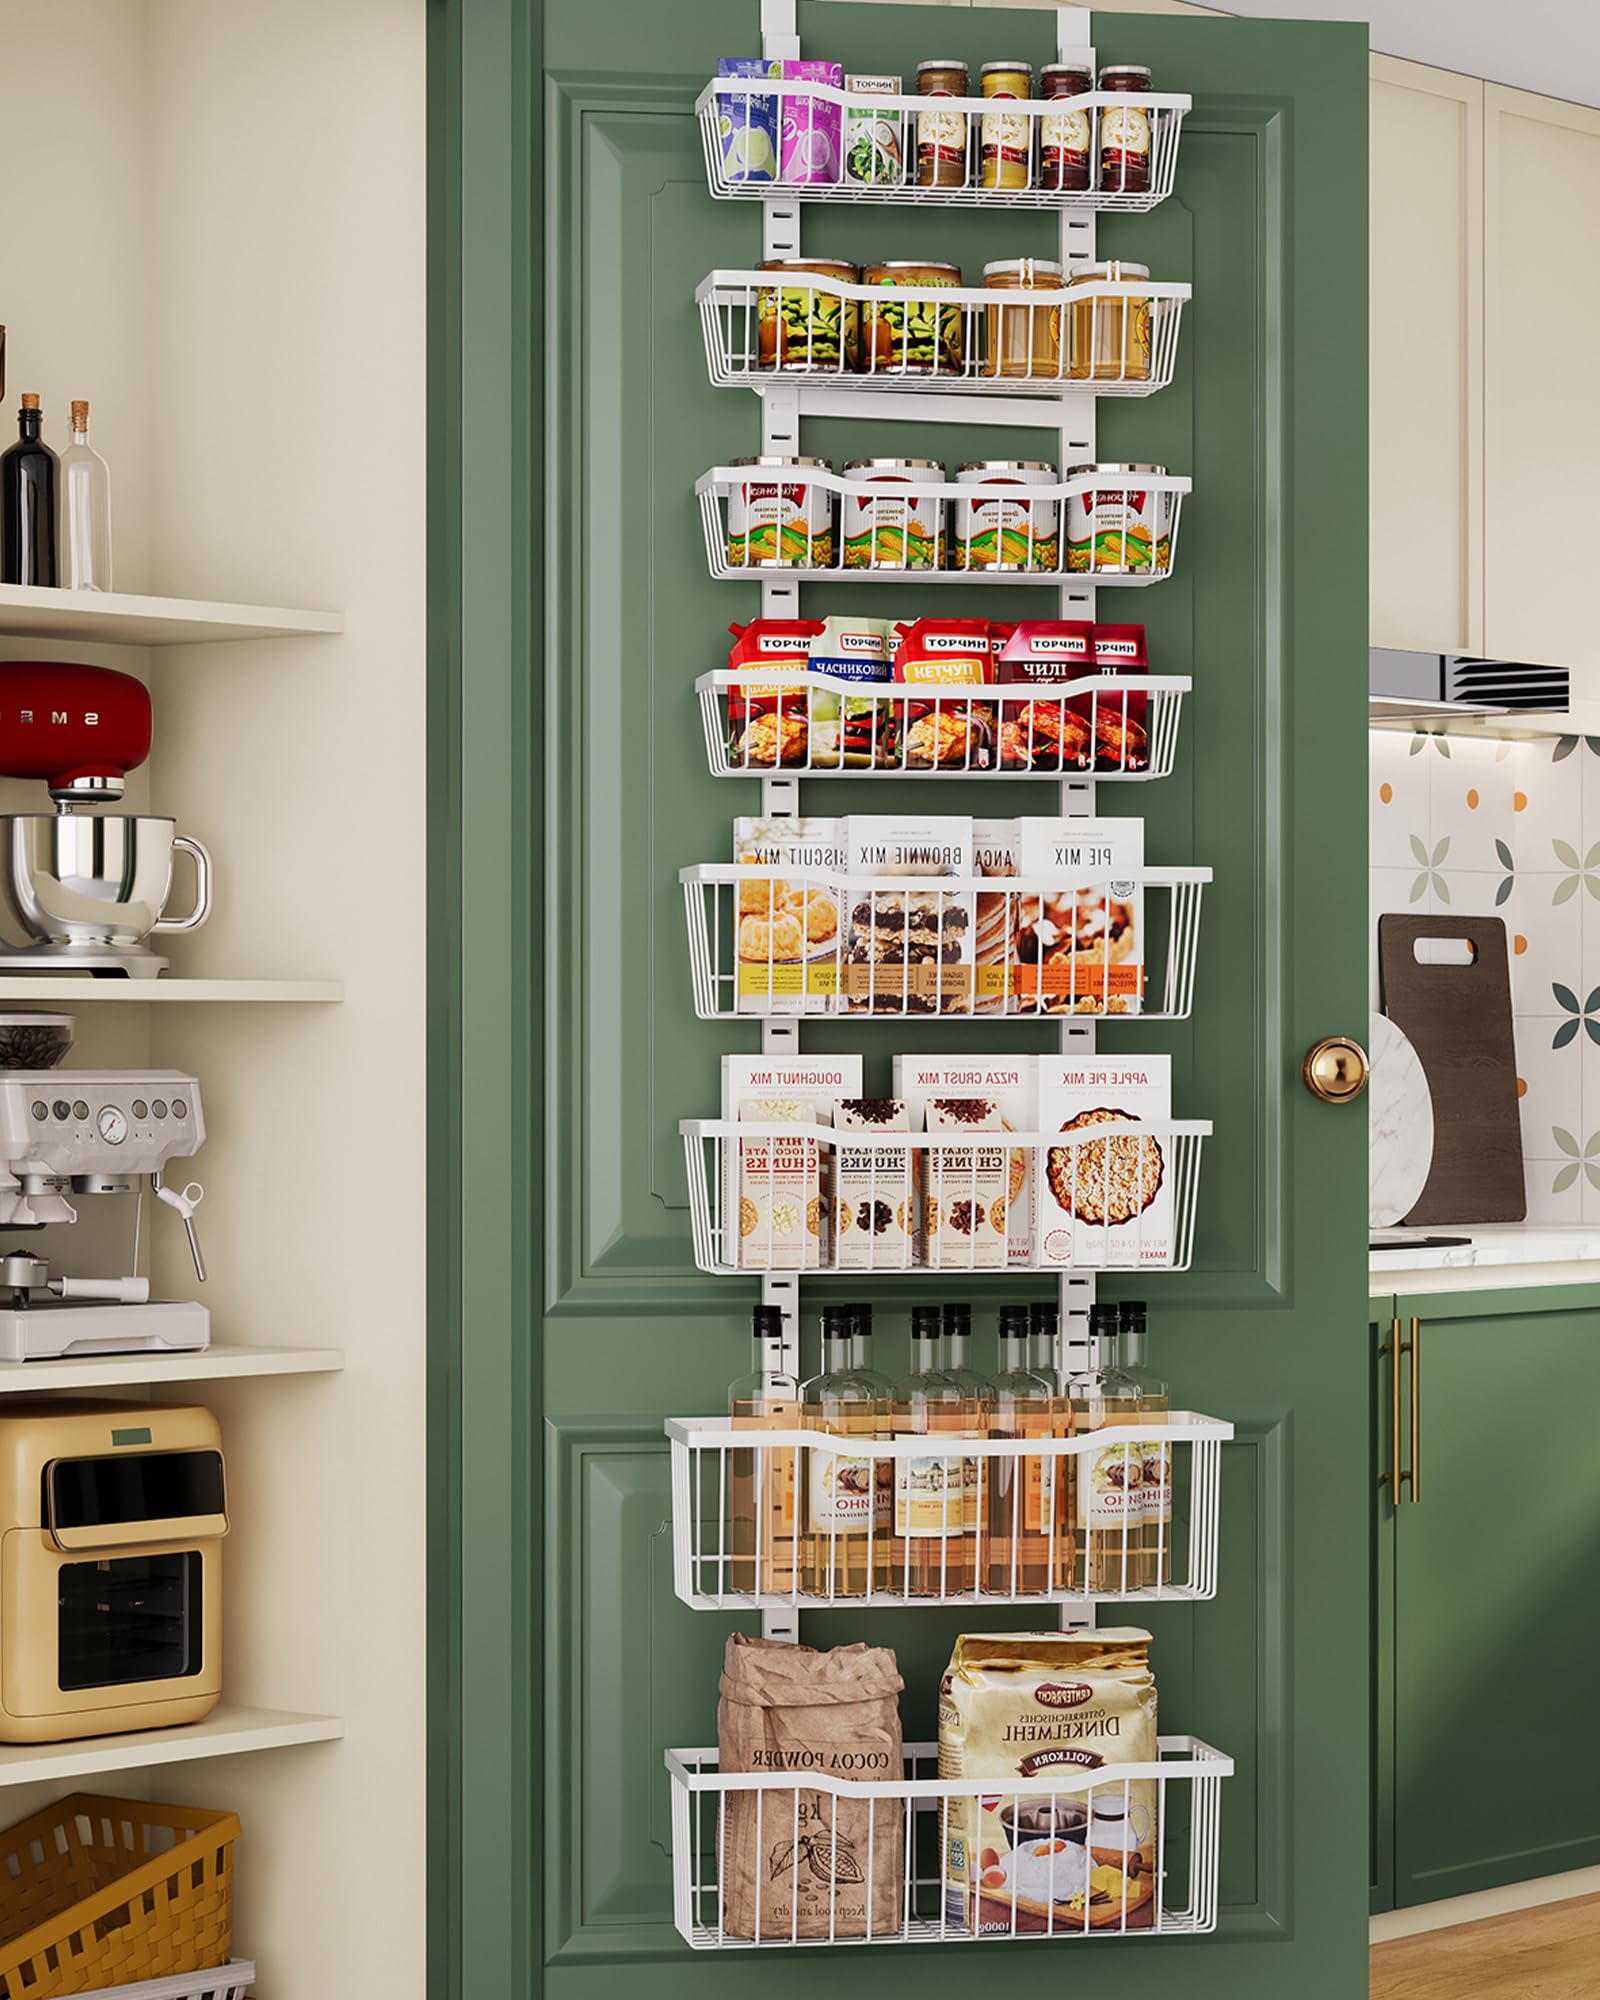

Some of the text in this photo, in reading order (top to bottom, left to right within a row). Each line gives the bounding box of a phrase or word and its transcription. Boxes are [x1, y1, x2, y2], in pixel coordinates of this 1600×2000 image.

[763, 638, 811, 649] ТОРЧИ
[844, 638, 881, 648] ТОРЧИН
[927, 638, 987, 649] ТОРЧИН
[1032, 639, 1084, 650] ТОРЧИН
[1095, 643, 1135, 653] ОРЧИН
[914, 664, 973, 679] КЕТЧУП
[1023, 664, 1067, 676] ЧИЛІ
[1101, 667, 1118, 676] ЛІ
